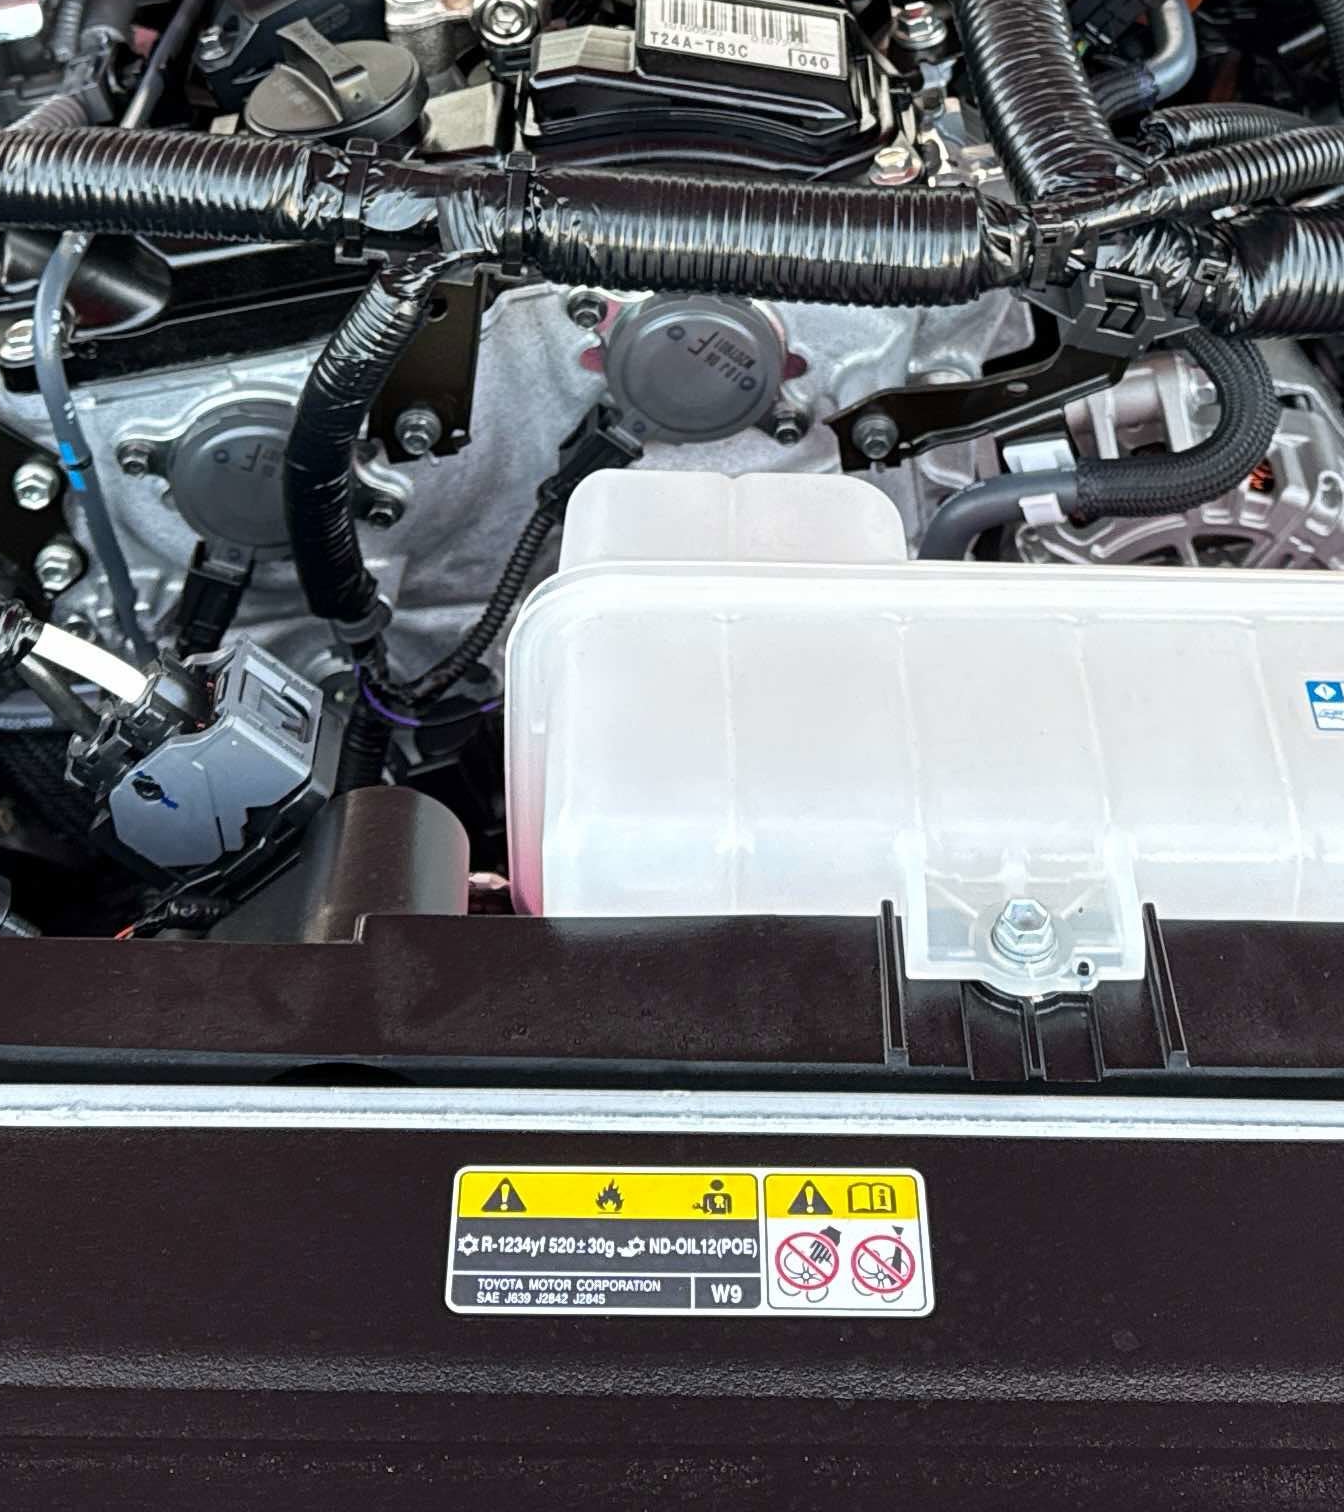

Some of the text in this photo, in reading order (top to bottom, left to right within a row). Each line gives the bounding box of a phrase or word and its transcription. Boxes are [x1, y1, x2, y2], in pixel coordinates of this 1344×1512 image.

[797, 53, 830, 70] 040
[481, 1236, 758, 1258] R-1234yf 520±30g ND-OIL12(POE)
[477, 1278, 661, 1292] TOYOTA MOTOR CORPORATION
[476, 1292, 500, 1304] SAE
[535, 1293, 569, 1305] J2842
[710, 1284, 743, 1304] W9
